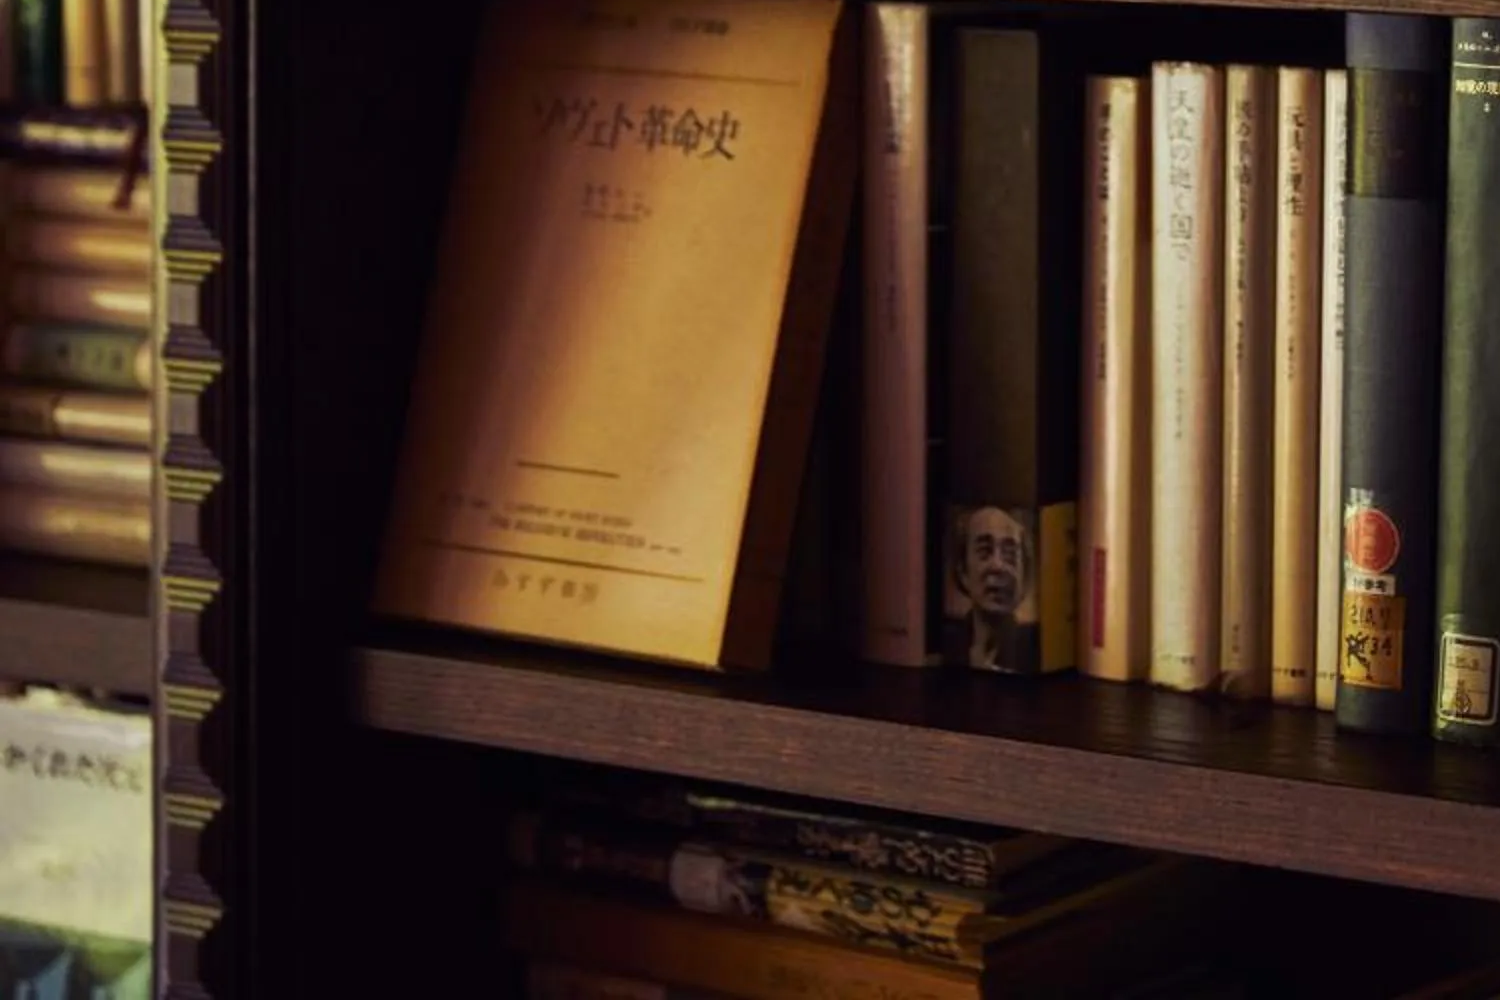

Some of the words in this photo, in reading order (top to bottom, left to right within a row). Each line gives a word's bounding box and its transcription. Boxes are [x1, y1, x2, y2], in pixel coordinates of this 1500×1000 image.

[533, 92, 742, 162] ソヴェト革命史
